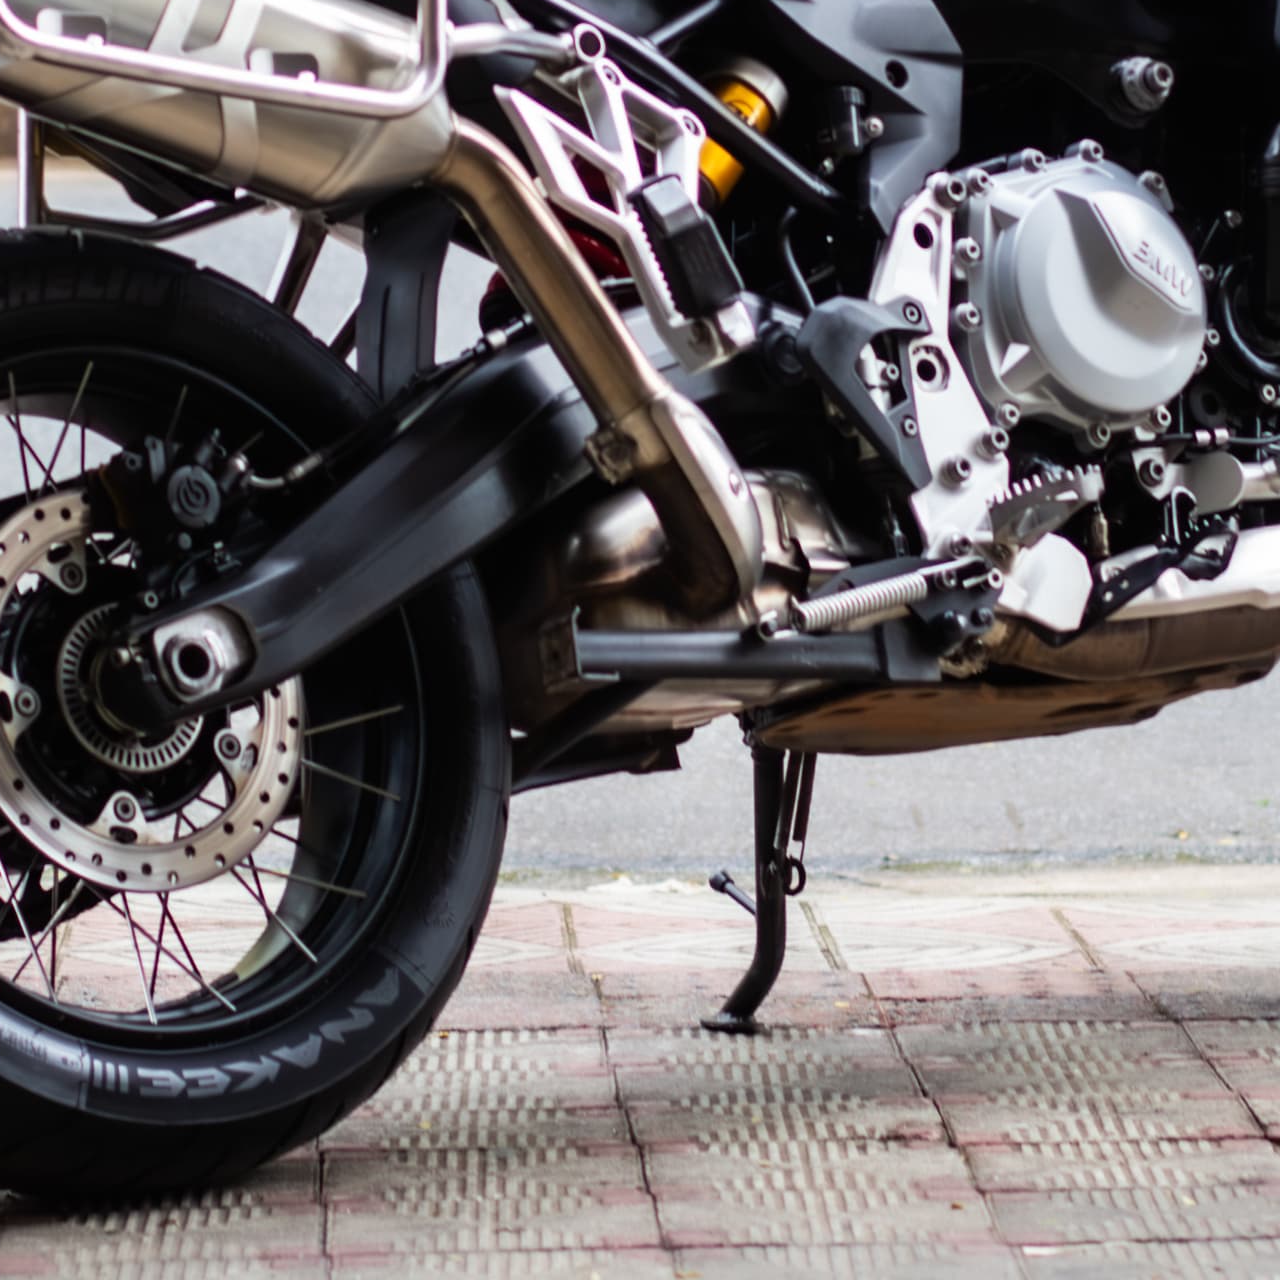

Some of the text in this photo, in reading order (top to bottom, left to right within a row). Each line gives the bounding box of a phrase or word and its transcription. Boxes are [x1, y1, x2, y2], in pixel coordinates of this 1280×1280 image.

[1131, 240, 1193, 297] BMW
[137, 967, 400, 1098] ANAKEE
[93, 1058, 129, 1094] III
